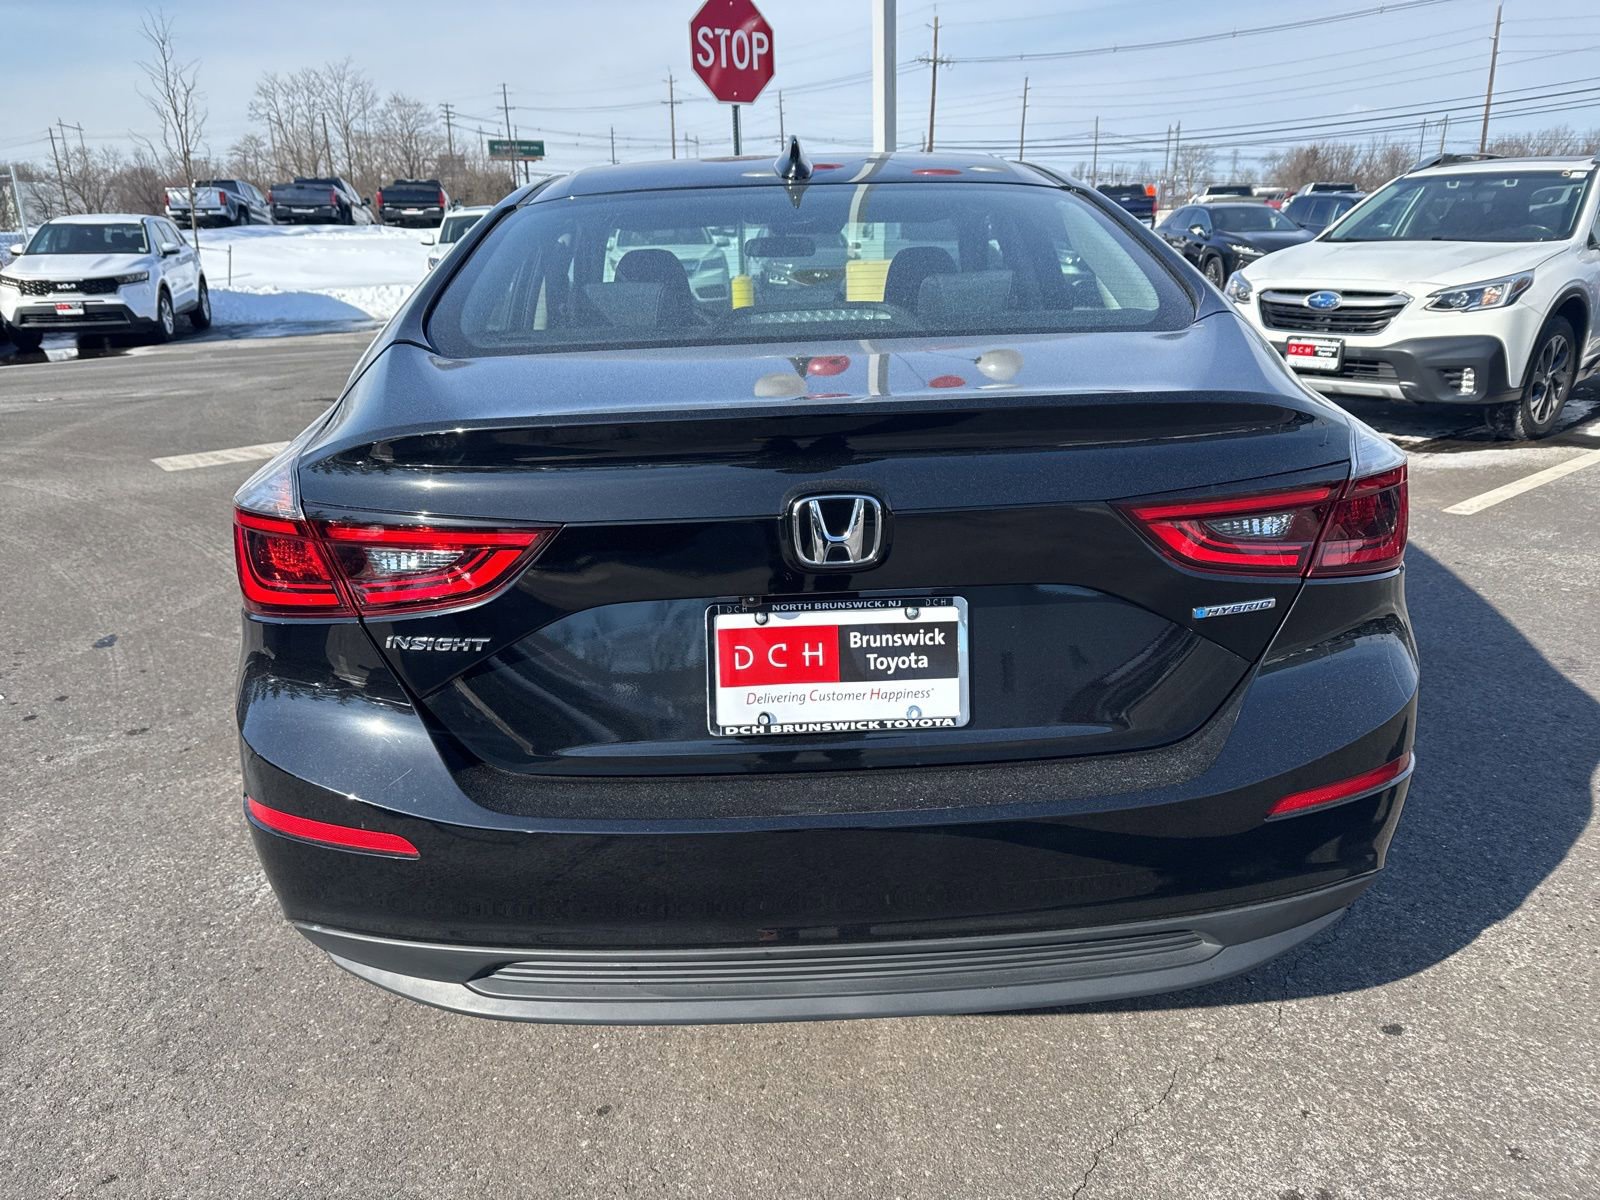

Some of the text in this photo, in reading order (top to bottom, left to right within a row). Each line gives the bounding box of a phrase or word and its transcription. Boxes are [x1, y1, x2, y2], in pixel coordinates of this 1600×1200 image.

[697, 26, 769, 70] STOP
[772, 602, 812, 612] NORTH
[888, 599, 902, 608] NJ
[1207, 600, 1272, 617] HYBRID
[385, 635, 491, 652] INSIGHT
[849, 628, 945, 649] Brunswick
[866, 652, 929, 675] Toyota
[746, 691, 806, 706] Delivering
[809, 689, 867, 703] Customer
[725, 717, 955, 735] DCH BRUNSWICK TOYOTA
